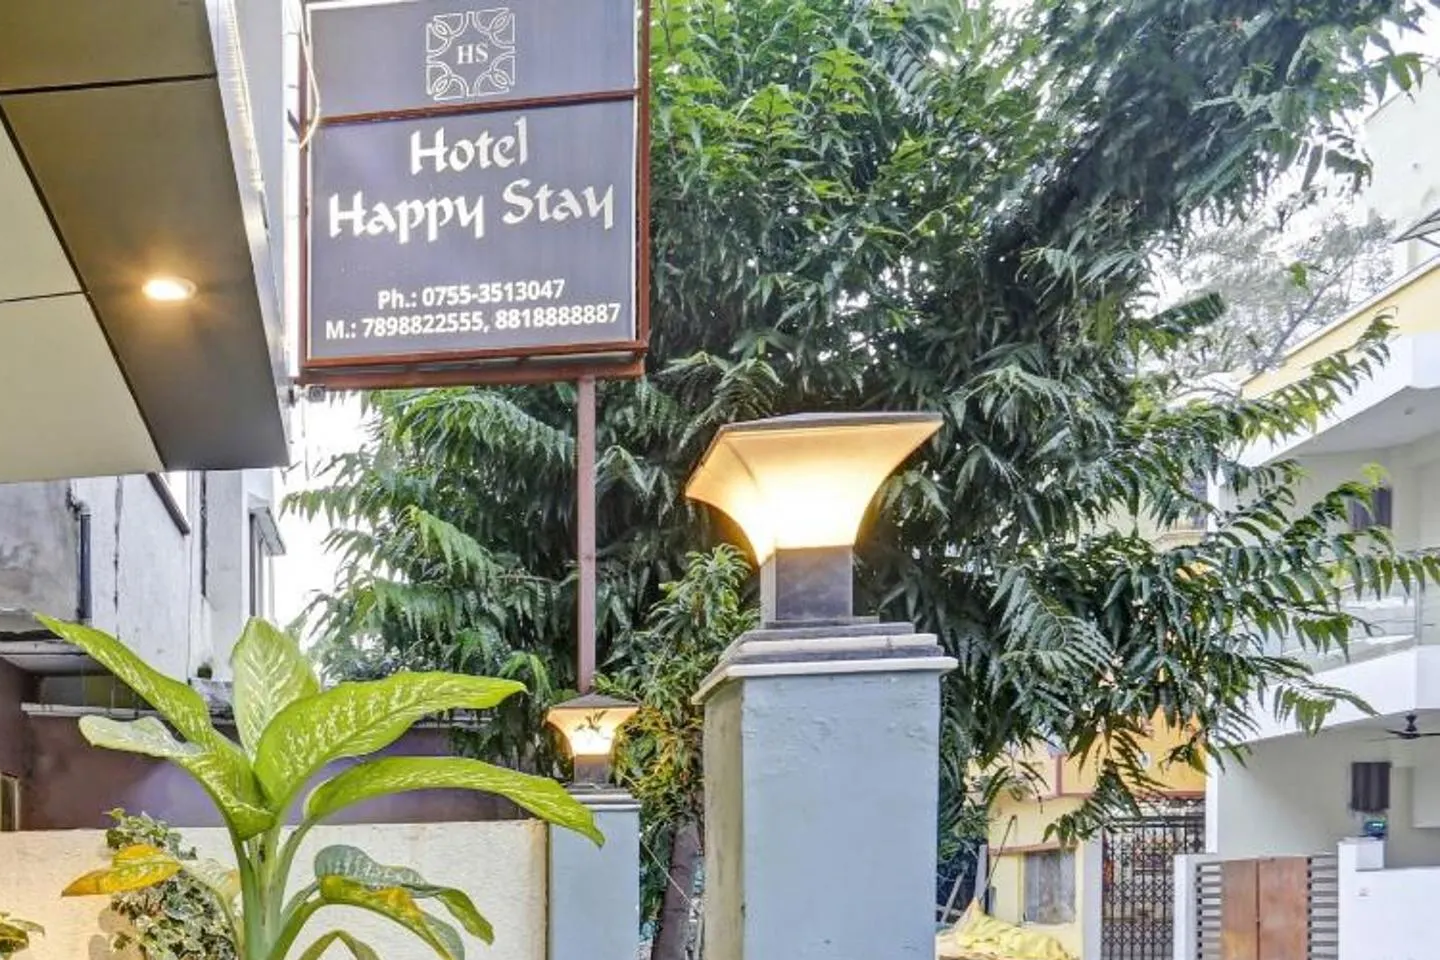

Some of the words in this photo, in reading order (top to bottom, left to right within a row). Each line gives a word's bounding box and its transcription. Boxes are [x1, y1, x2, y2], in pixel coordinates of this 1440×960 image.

[457, 44, 488, 64] HS
[410, 116, 529, 176] Hotel
[329, 190, 485, 245] Happy
[502, 177, 615, 231] Stay
[377, 287, 418, 311] Ph.:
[421, 278, 566, 307] 0755-3513047
[325, 319, 357, 341] M.:
[361, 310, 491, 339] 7898822555,
[494, 302, 622, 331] 8818888887
